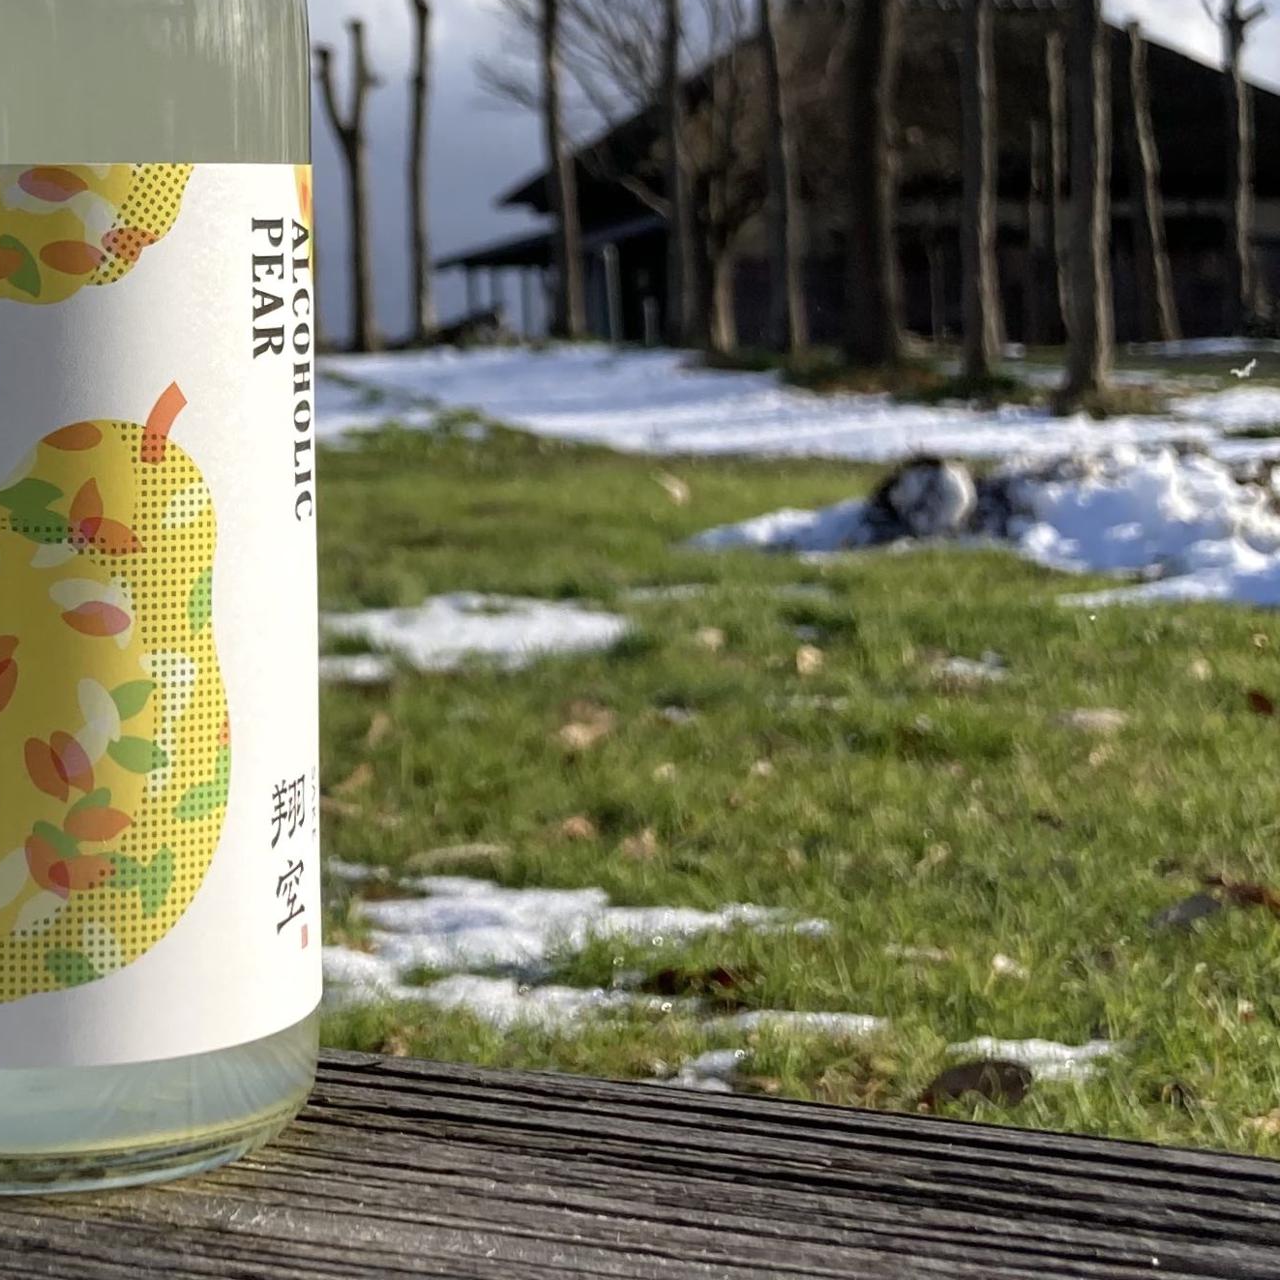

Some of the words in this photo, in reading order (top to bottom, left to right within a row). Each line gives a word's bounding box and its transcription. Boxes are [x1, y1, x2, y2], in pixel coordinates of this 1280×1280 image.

[251, 217, 285, 359] PEAR
[292, 218, 312, 521] ALCOHOLIC
[271, 774, 306, 935] 翔空
